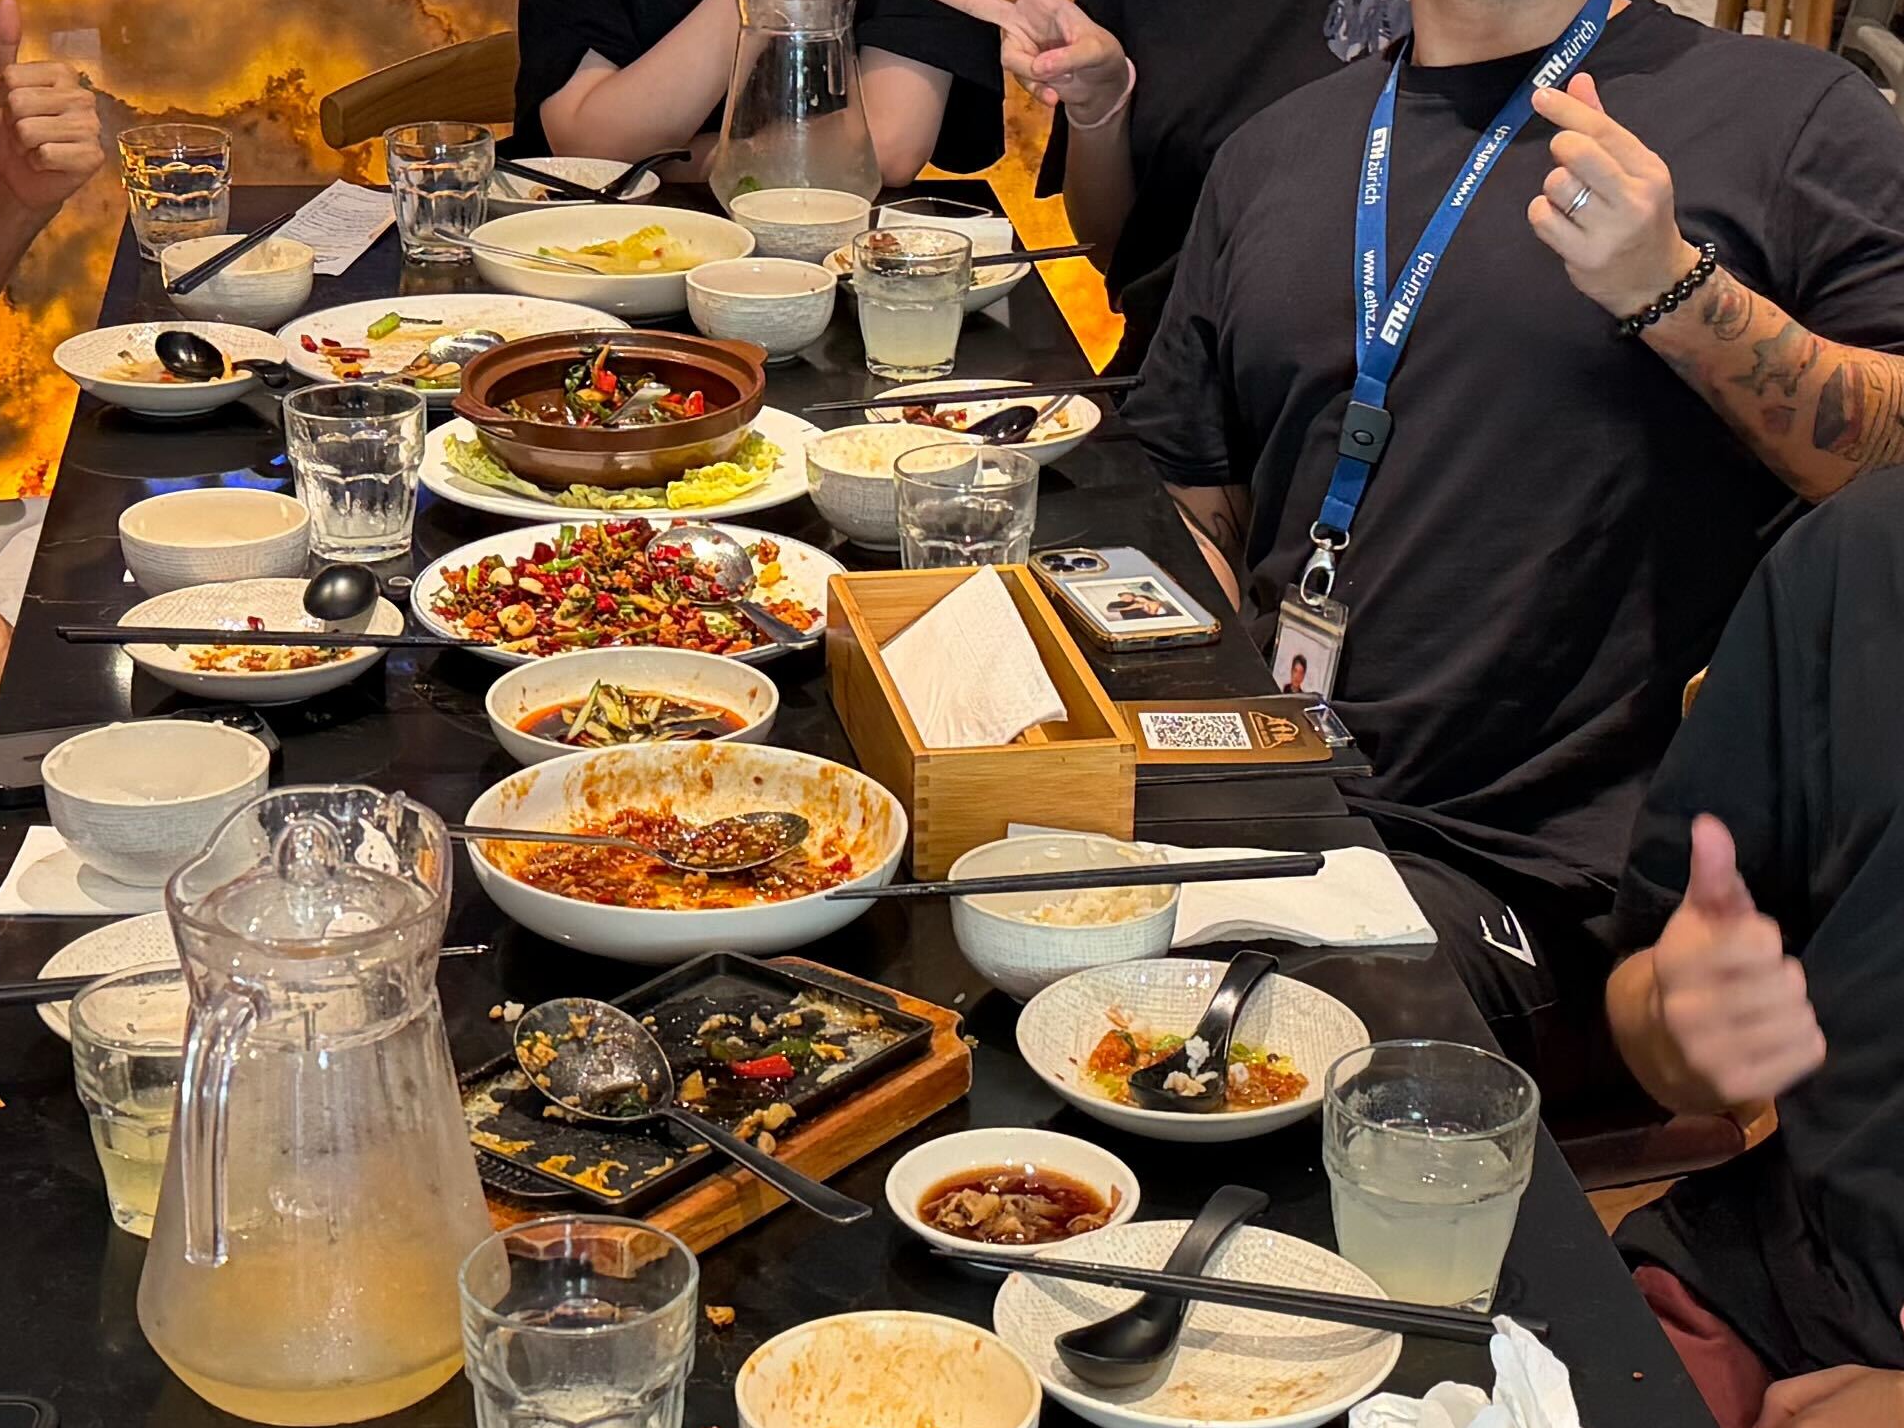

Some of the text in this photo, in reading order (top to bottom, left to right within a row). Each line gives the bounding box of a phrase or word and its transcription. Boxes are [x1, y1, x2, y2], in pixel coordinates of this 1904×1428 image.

[1531, 19, 1598, 90] ETH zürich
[1363, 126, 1388, 205] ETH zürich
[1450, 124, 1512, 208] www.ethz.ch
[1380, 251, 1436, 347] ETH zürich
